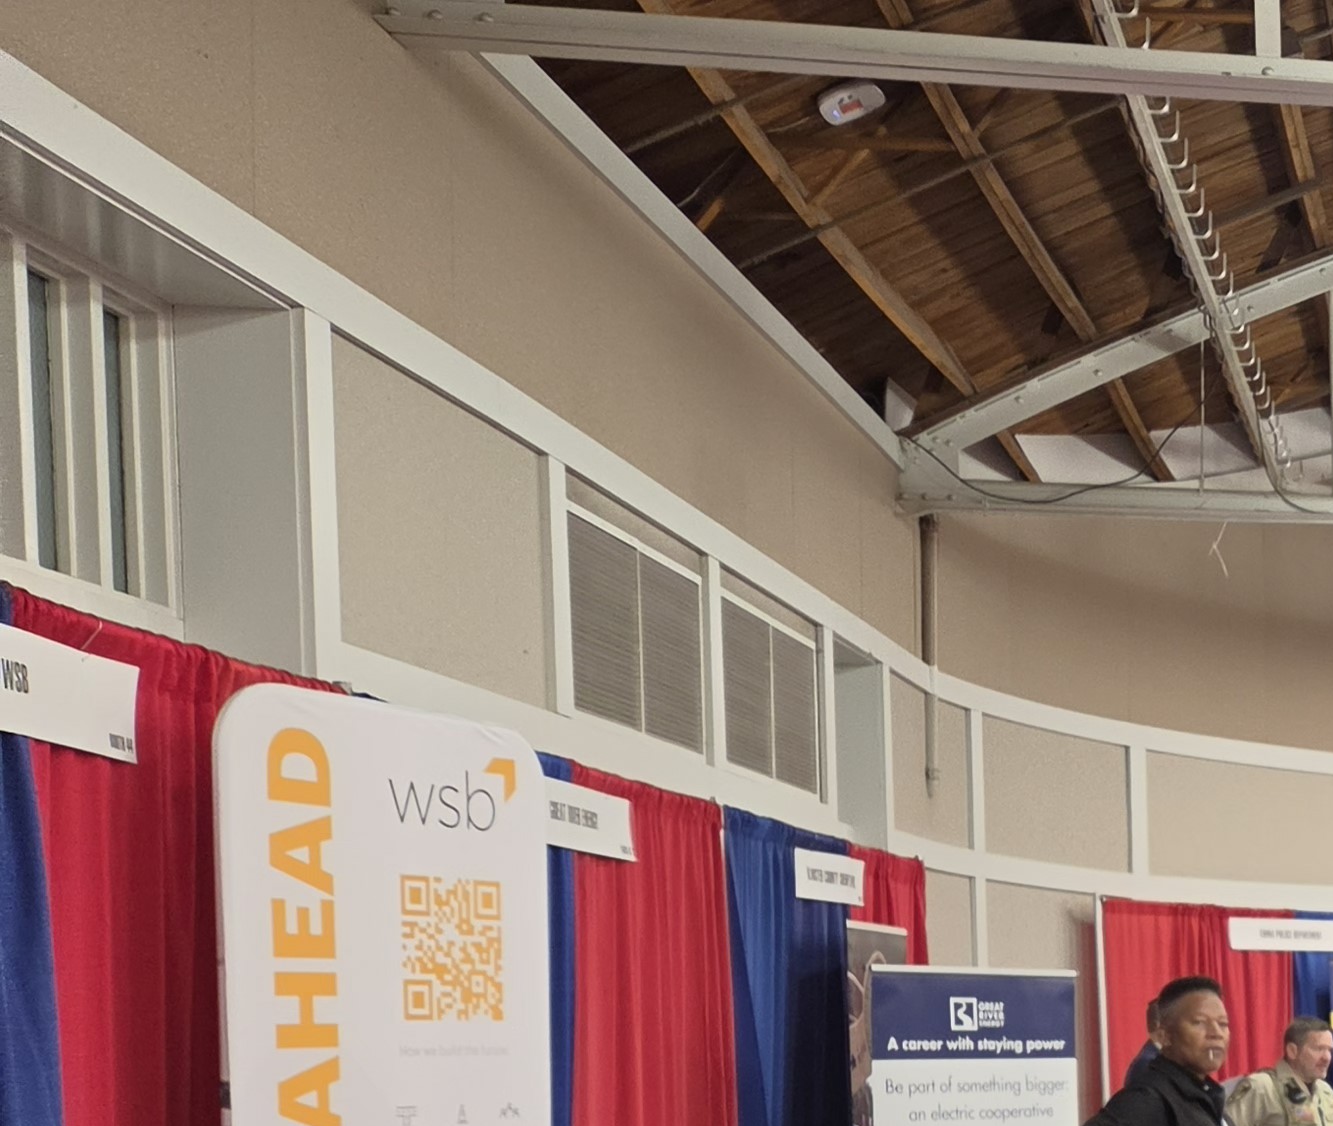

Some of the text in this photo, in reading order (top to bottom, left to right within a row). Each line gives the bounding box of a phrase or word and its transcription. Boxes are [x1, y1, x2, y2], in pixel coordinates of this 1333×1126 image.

[1, 658, 29, 694] WSB
[388, 770, 495, 831] wsb
[978, 1001, 1004, 1011] GREAT
[978, 1011, 1005, 1020] RIVER
[887, 1036, 1066, 1054] A career with staying power
[886, 1078, 904, 1095] Be
[908, 1081, 935, 1098] part
[939, 1075, 952, 1093] of
[957, 1075, 1021, 1096] something
[909, 1102, 1055, 1123] an electric cooperative
